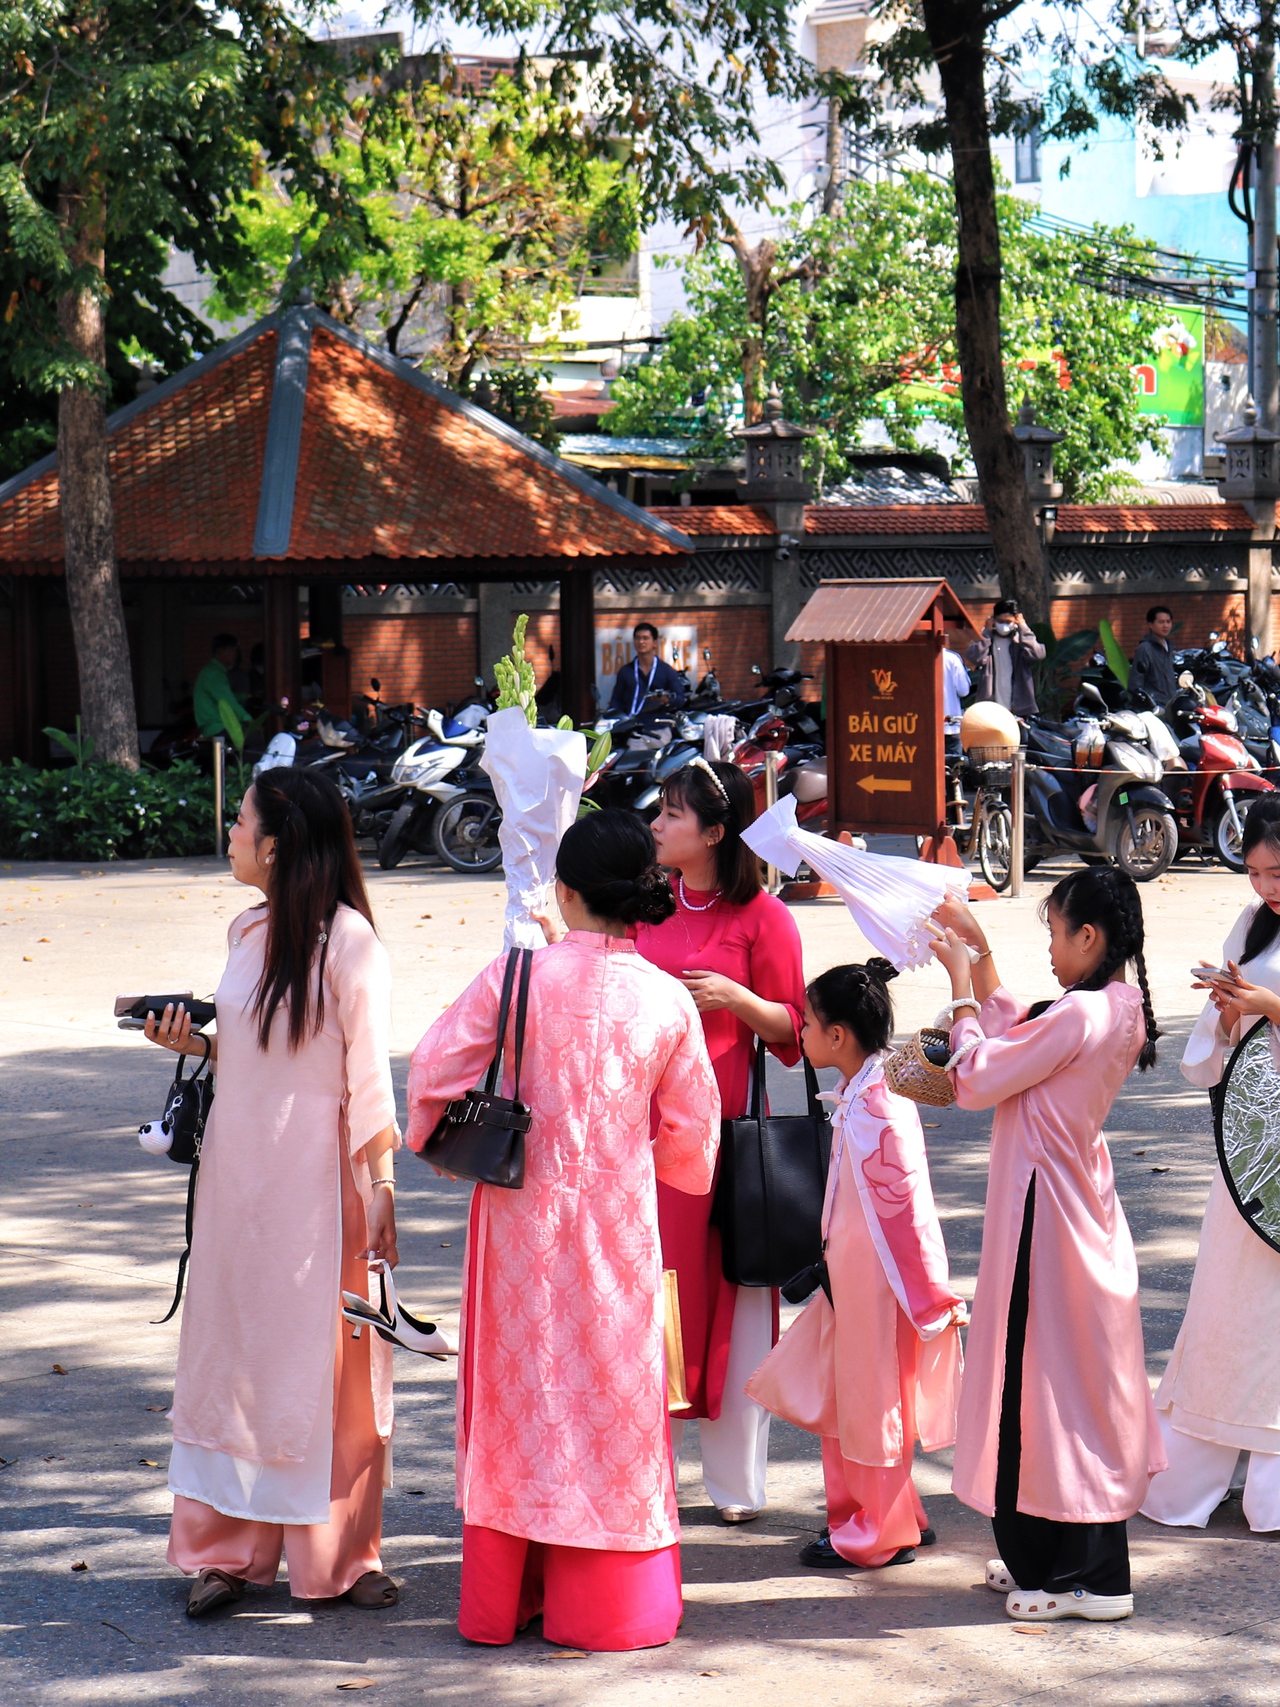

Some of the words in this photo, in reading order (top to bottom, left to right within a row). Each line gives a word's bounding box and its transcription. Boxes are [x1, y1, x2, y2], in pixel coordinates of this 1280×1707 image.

[602, 636, 632, 676] BÃI
[848, 711, 879, 733] BÃI
[882, 712, 919, 735] GIỮ
[849, 744, 873, 762] XE
[876, 741, 918, 763] MÁY
